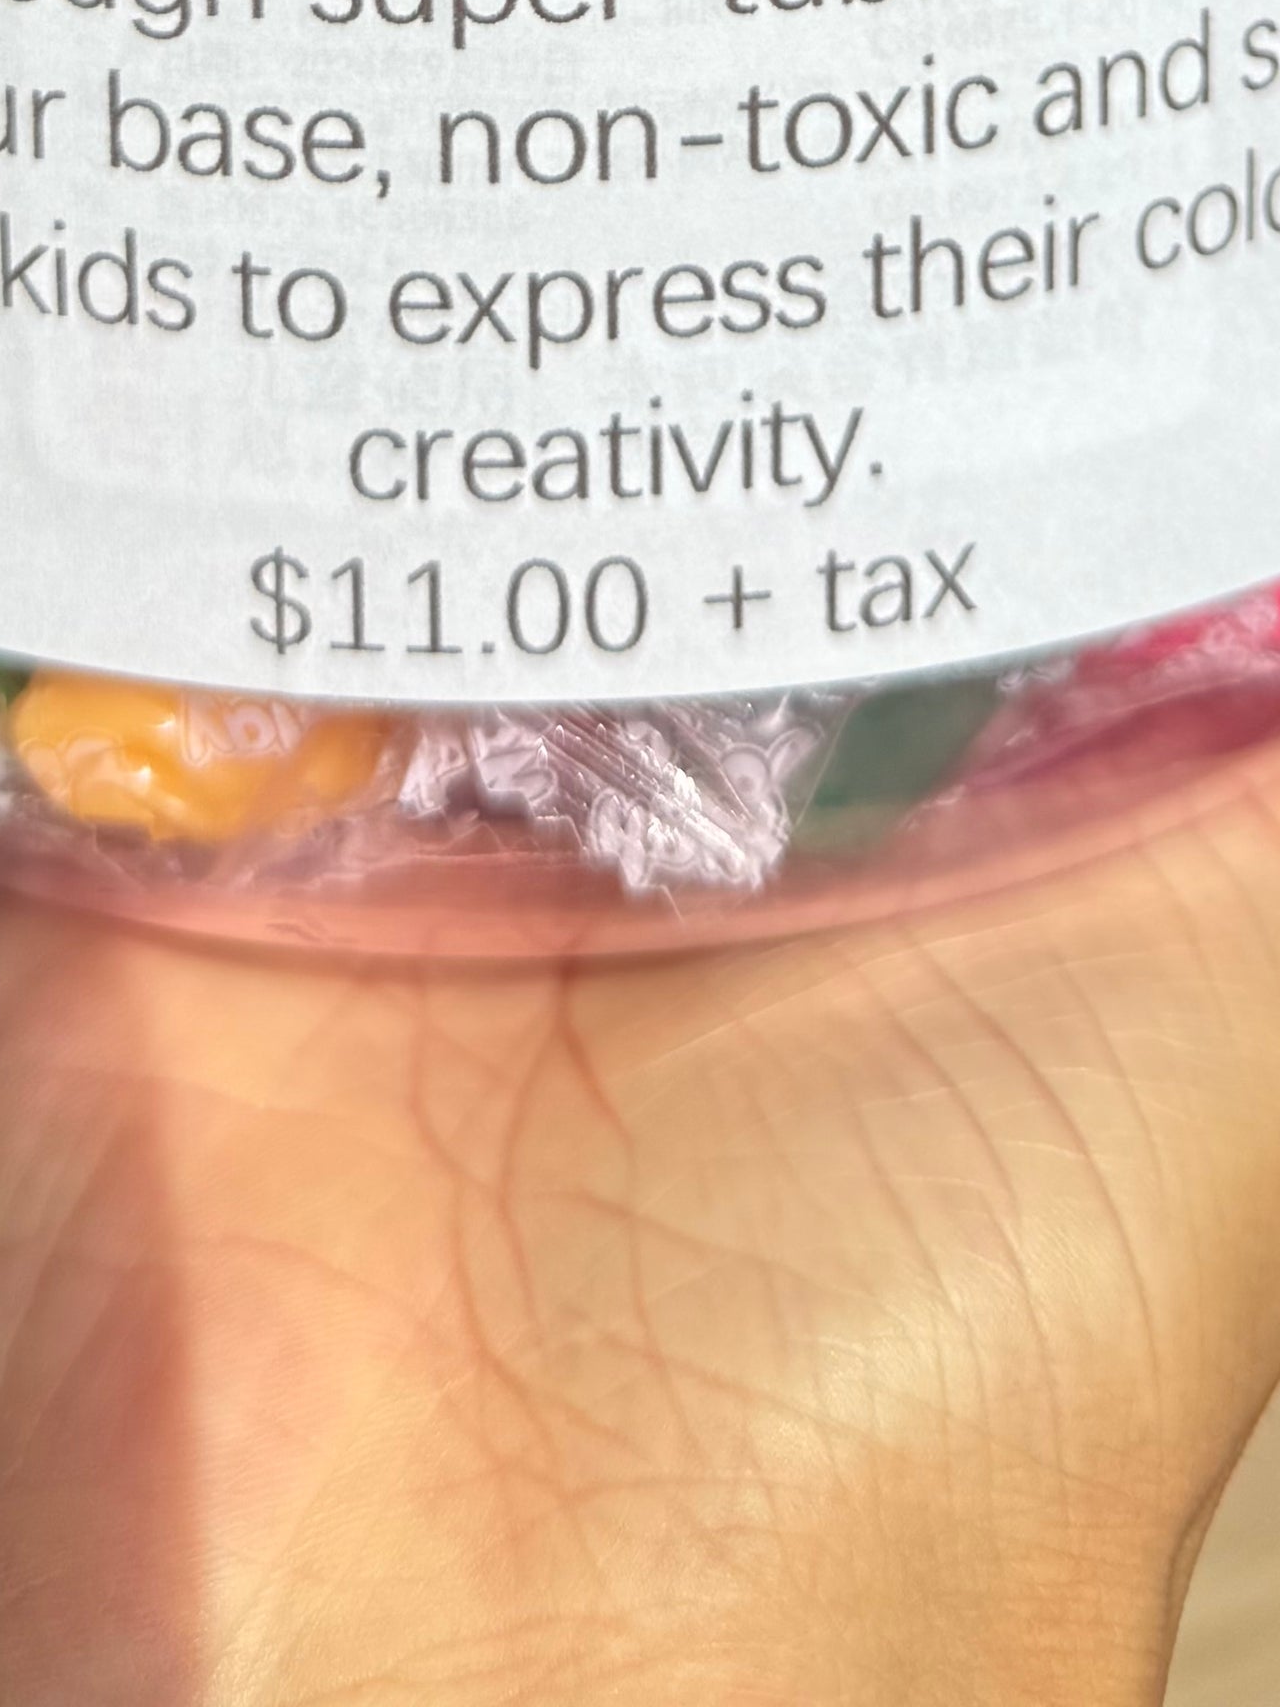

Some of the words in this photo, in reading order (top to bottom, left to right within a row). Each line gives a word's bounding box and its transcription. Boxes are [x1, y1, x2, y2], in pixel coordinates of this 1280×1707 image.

[106, 68, 392, 201] base,
[438, 53, 1000, 187] non-toxic
[1032, 8, 1213, 140] and
[230, 251, 349, 345] to
[386, 254, 828, 373] express
[861, 194, 1100, 322] their
[347, 390, 884, 510] creativity.
[248, 547, 650, 657] $11.00
[704, 566, 772, 632] +
[817, 544, 976, 635] tax
